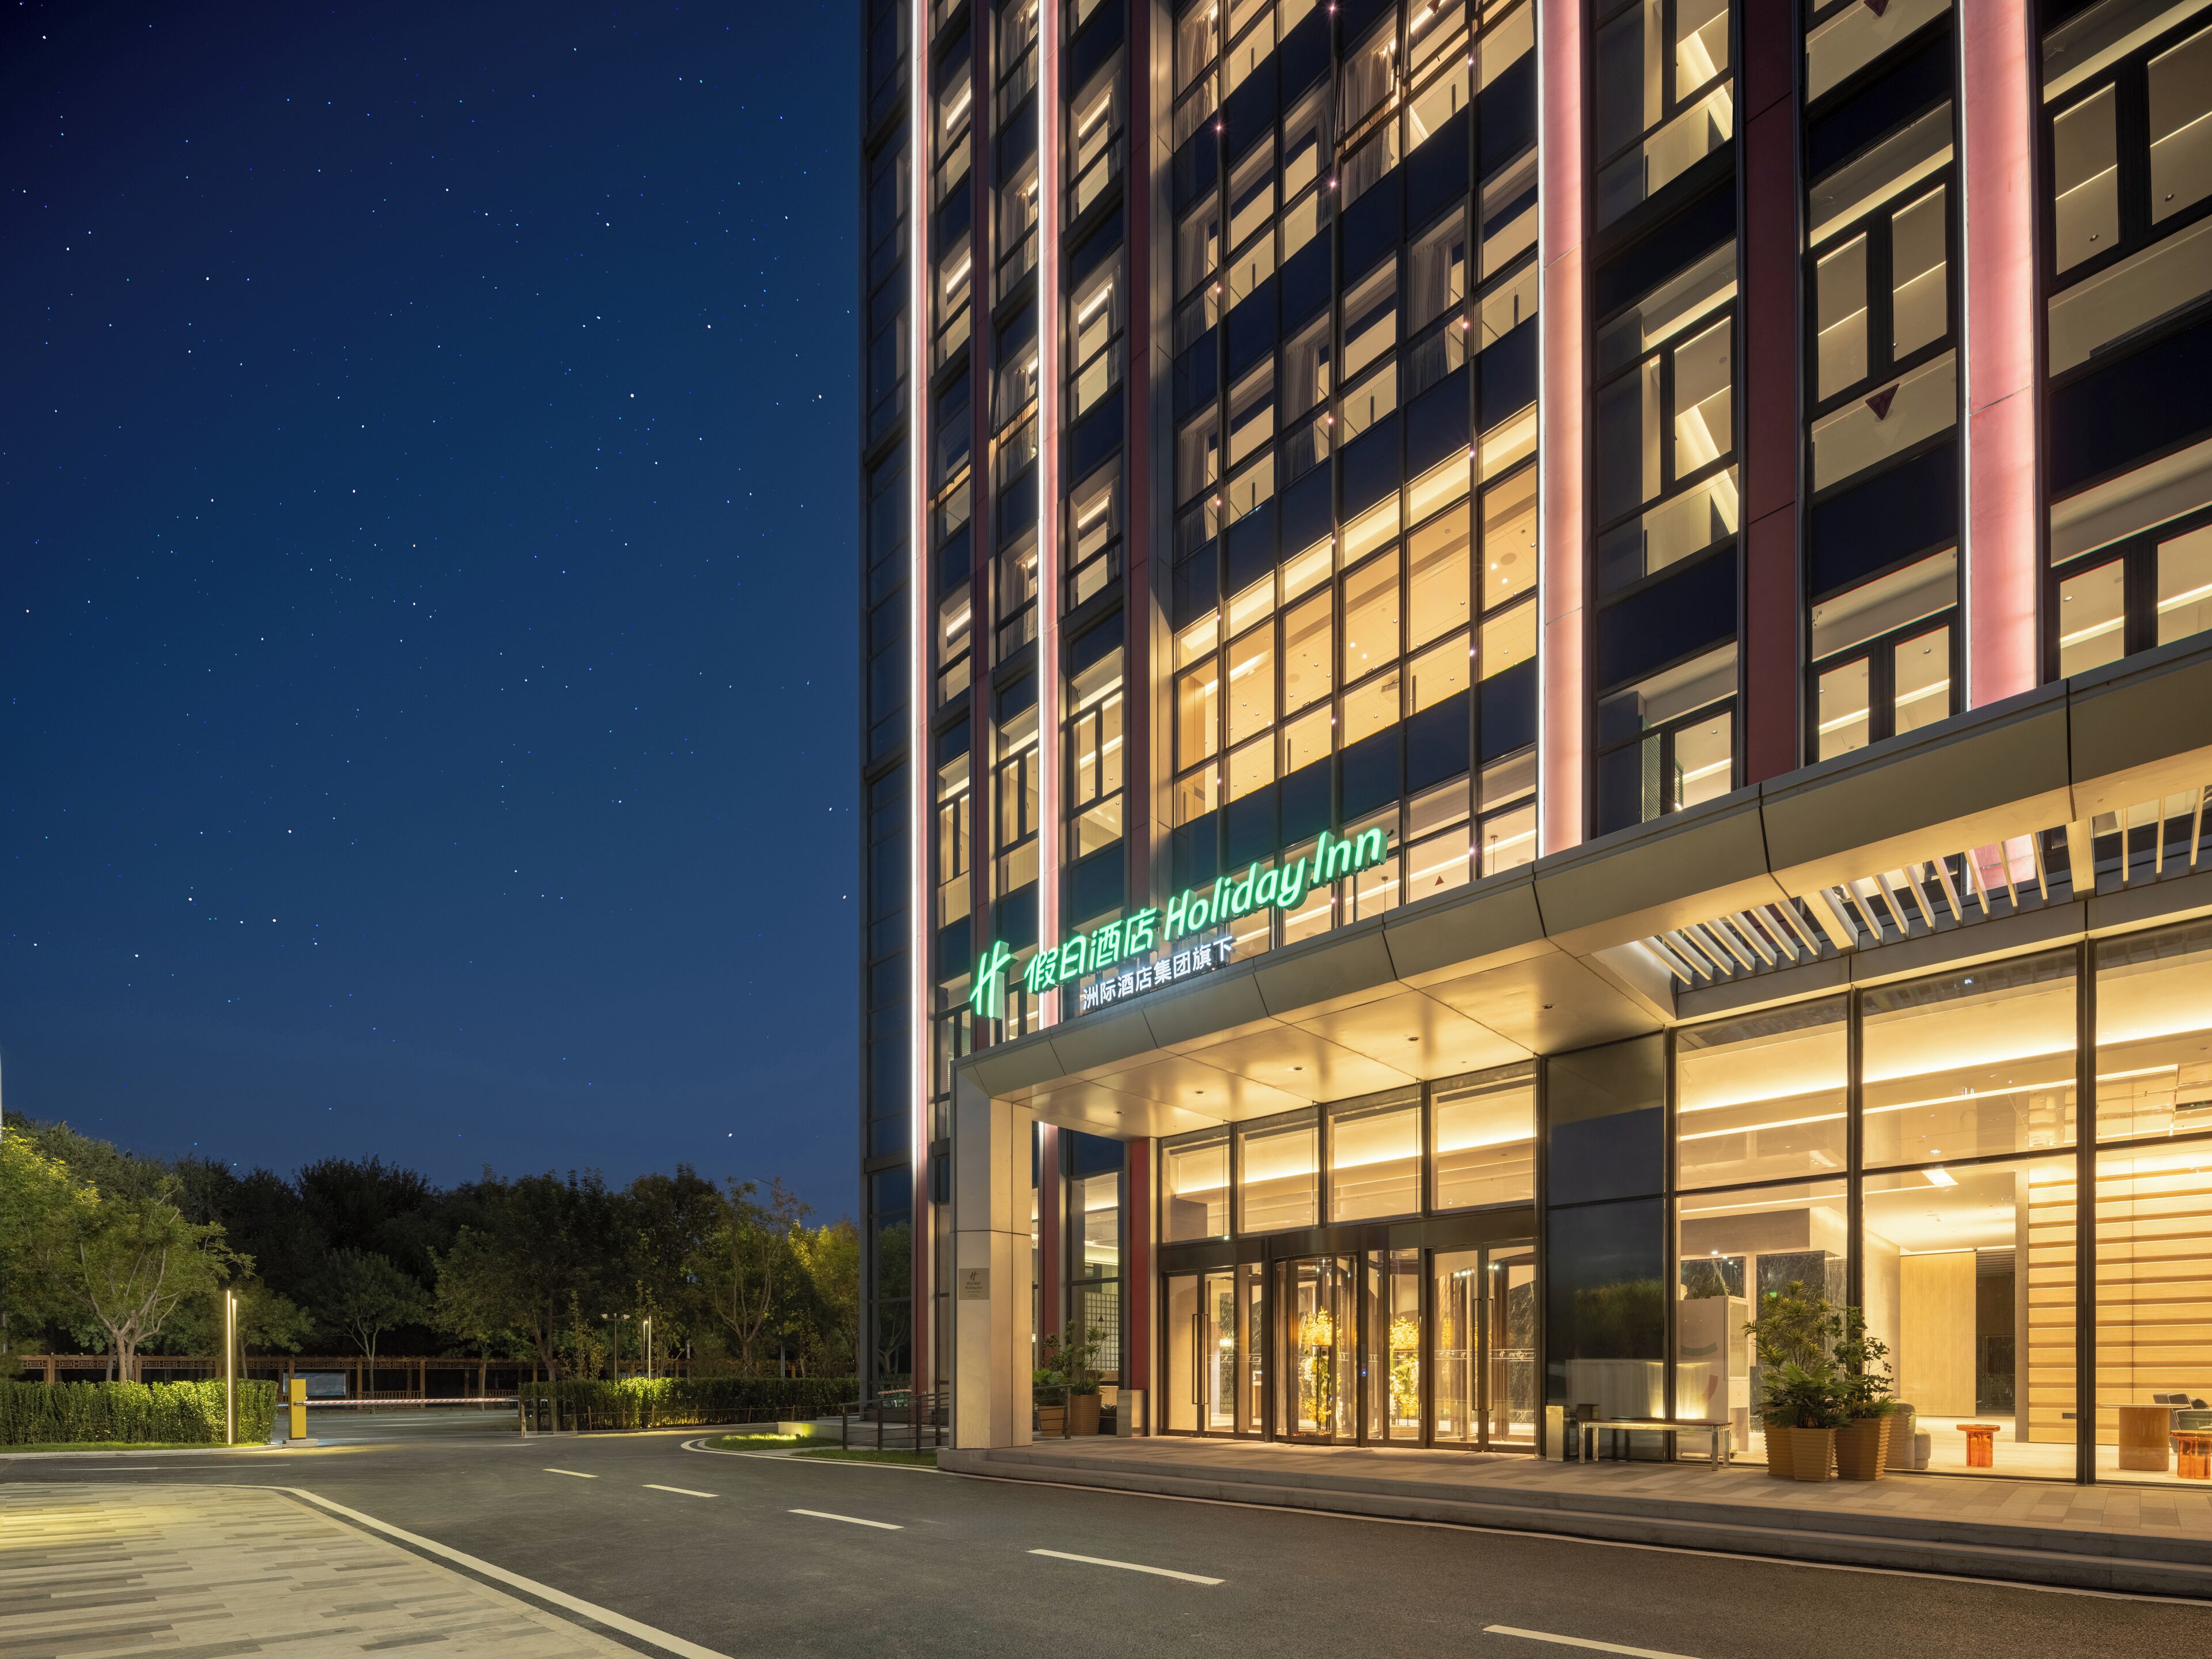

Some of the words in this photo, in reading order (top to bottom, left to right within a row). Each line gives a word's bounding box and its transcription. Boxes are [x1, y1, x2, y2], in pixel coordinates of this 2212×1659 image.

[1024, 907, 1157, 994] 假日酒店
[1164, 857, 1308, 941] Holiday
[1313, 827, 1382, 884] Inn
[1083, 935, 1233, 1010] 洲际酒店集团旗下
